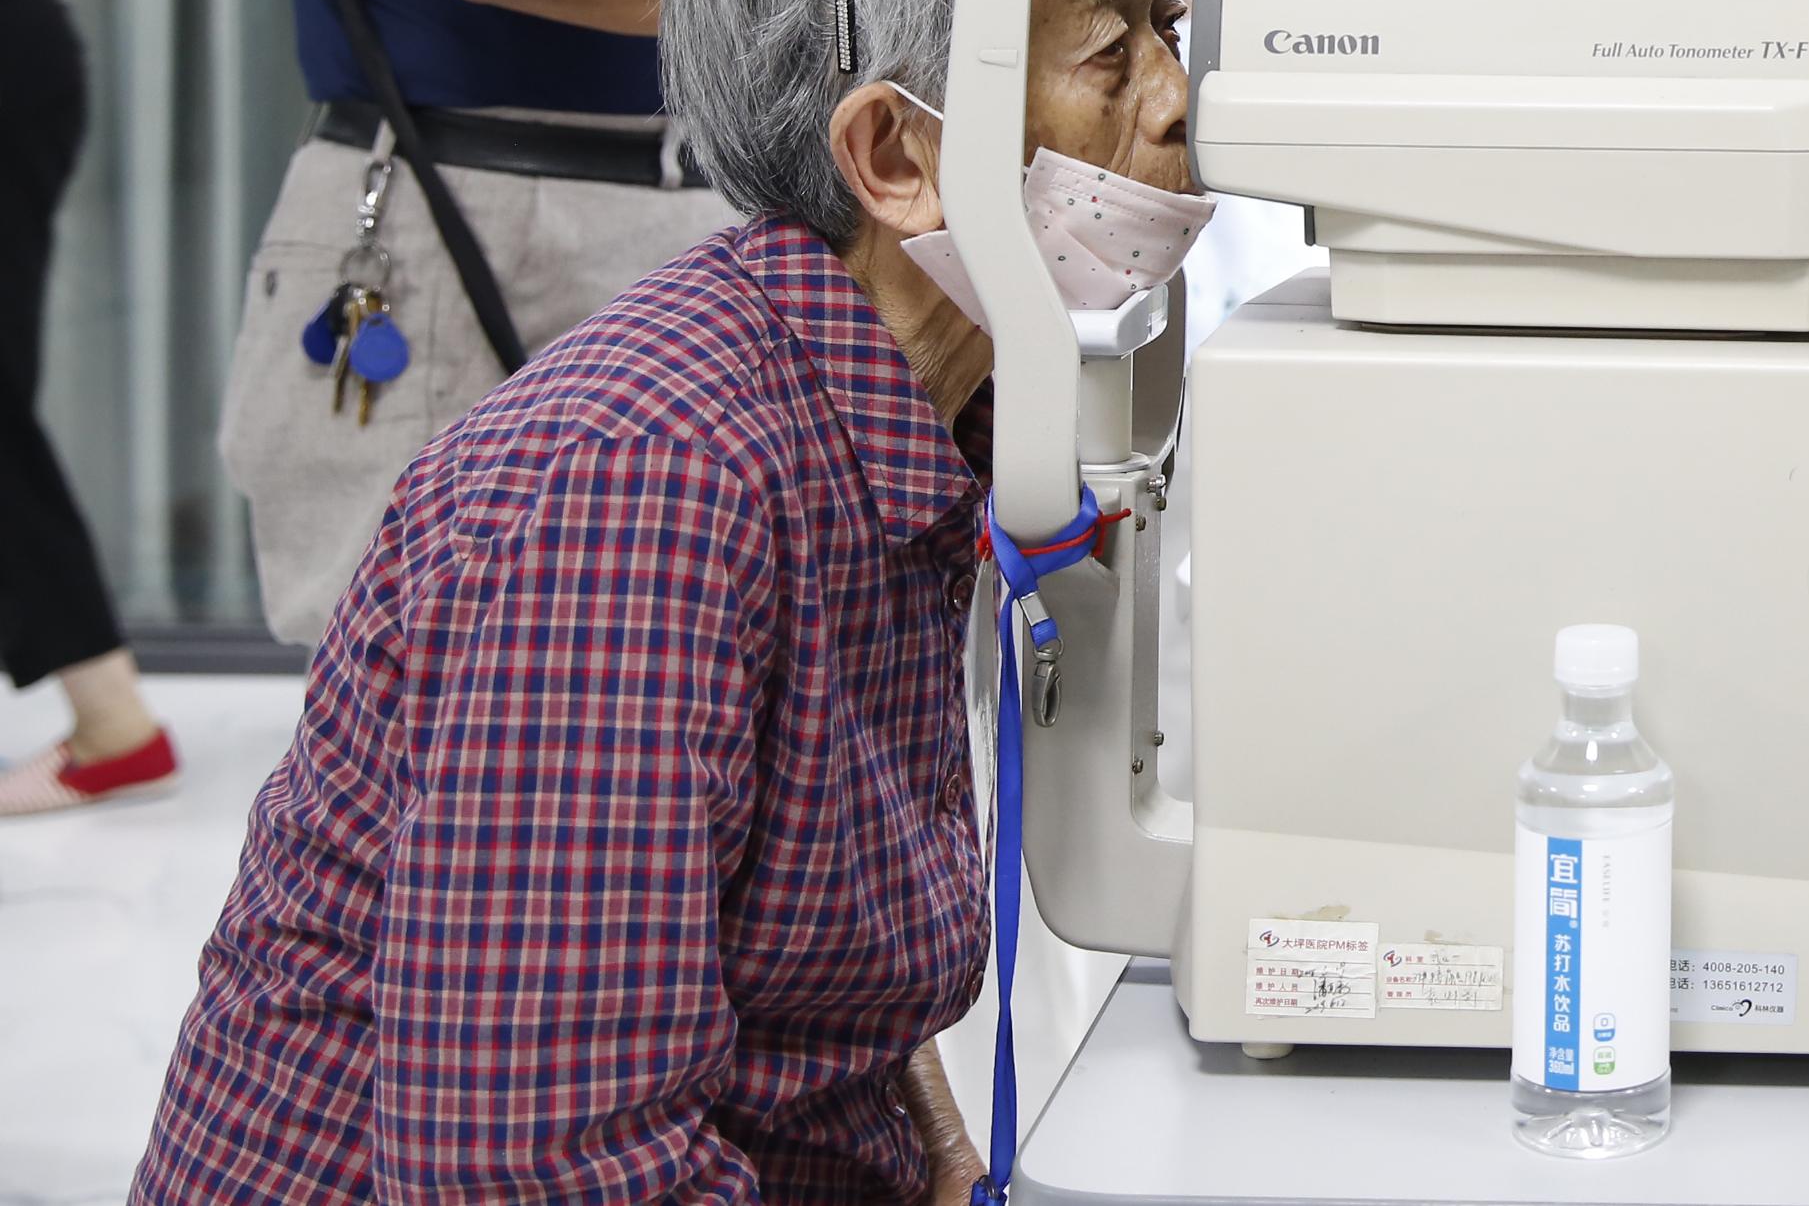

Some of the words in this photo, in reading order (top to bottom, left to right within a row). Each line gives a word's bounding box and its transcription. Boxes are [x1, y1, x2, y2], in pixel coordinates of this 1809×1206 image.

[1263, 29, 1380, 55] Canon
[1592, 42, 1623, 58] Full
[1625, 43, 1665, 59] Auto
[1668, 43, 1755, 60] Tonometer
[1760, 41, 1809, 60] TX-F
[1282, 937, 1369, 952] 大坪医院PM标签
[1702, 961, 1785, 976] 4008-205-140
[1552, 933, 1573, 1033] 苏打水饮品
[1702, 979, 1784, 993] 13651612712
